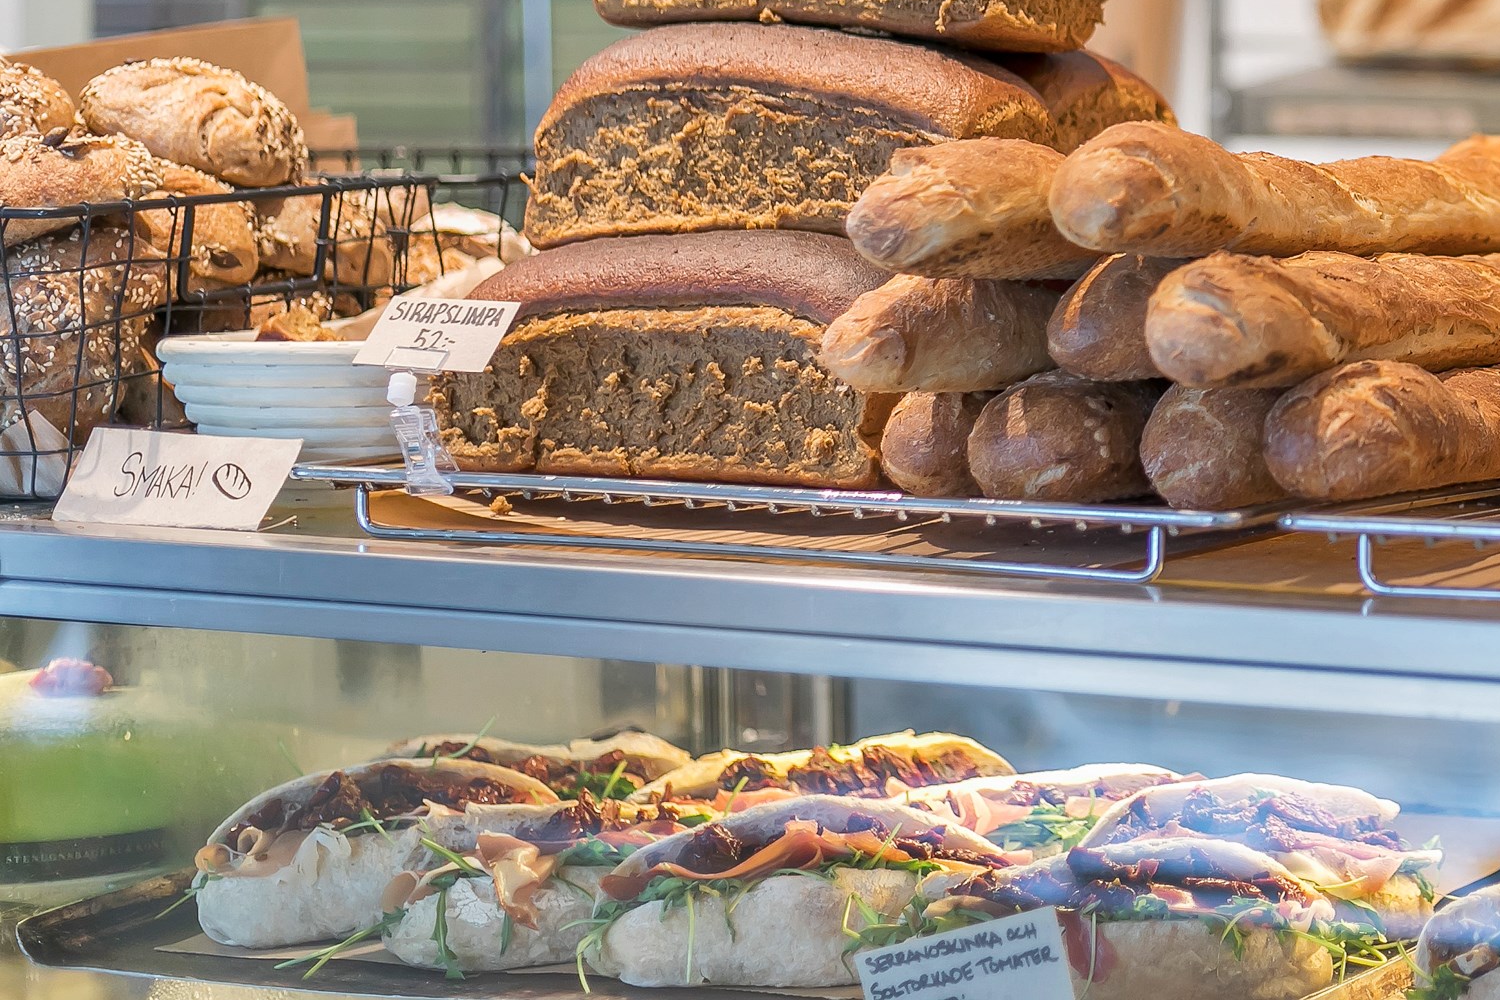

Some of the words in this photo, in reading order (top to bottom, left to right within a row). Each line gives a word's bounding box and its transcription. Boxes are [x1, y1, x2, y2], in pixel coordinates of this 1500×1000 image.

[388, 301, 506, 328] SIRAPSLIMPA
[413, 328, 456, 350] 52:-
[114, 451, 209, 499] SMAKA!
[864, 931, 1003, 976] SERRANOSKINKA
[1006, 922, 1037, 942] OCH
[870, 961, 975, 1000] SOLTORKADE
[975, 945, 1060, 975] TOMATER
